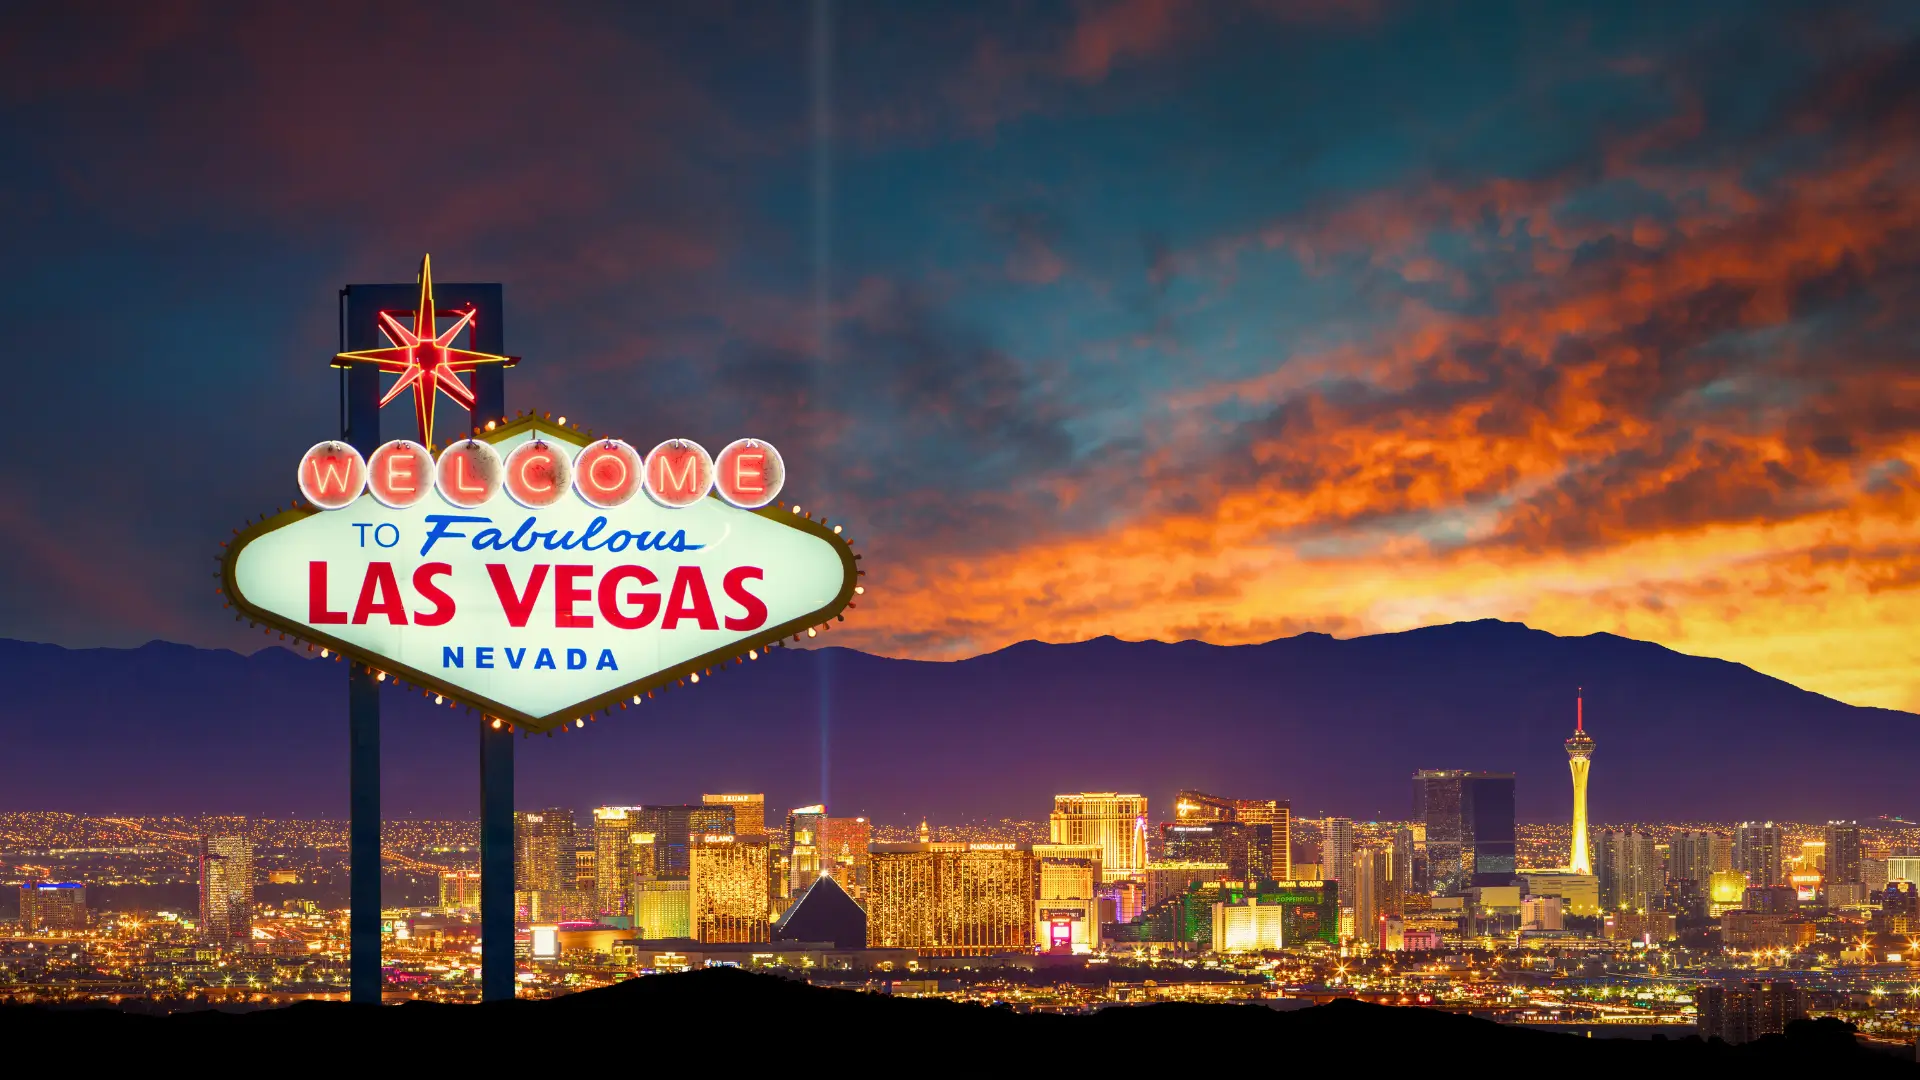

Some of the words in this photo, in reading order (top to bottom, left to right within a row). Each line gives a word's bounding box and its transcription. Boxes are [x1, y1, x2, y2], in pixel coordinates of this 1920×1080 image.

[308, 453, 767, 495] WELCOME
[352, 522, 400, 549] TO
[420, 514, 706, 557] Fabulous
[308, 561, 457, 626] LAS
[485, 563, 768, 631] VEGAS
[442, 646, 619, 671] NEVADA
[704, 835, 735, 843] DELANO
[1203, 881, 1221, 889] MGM
